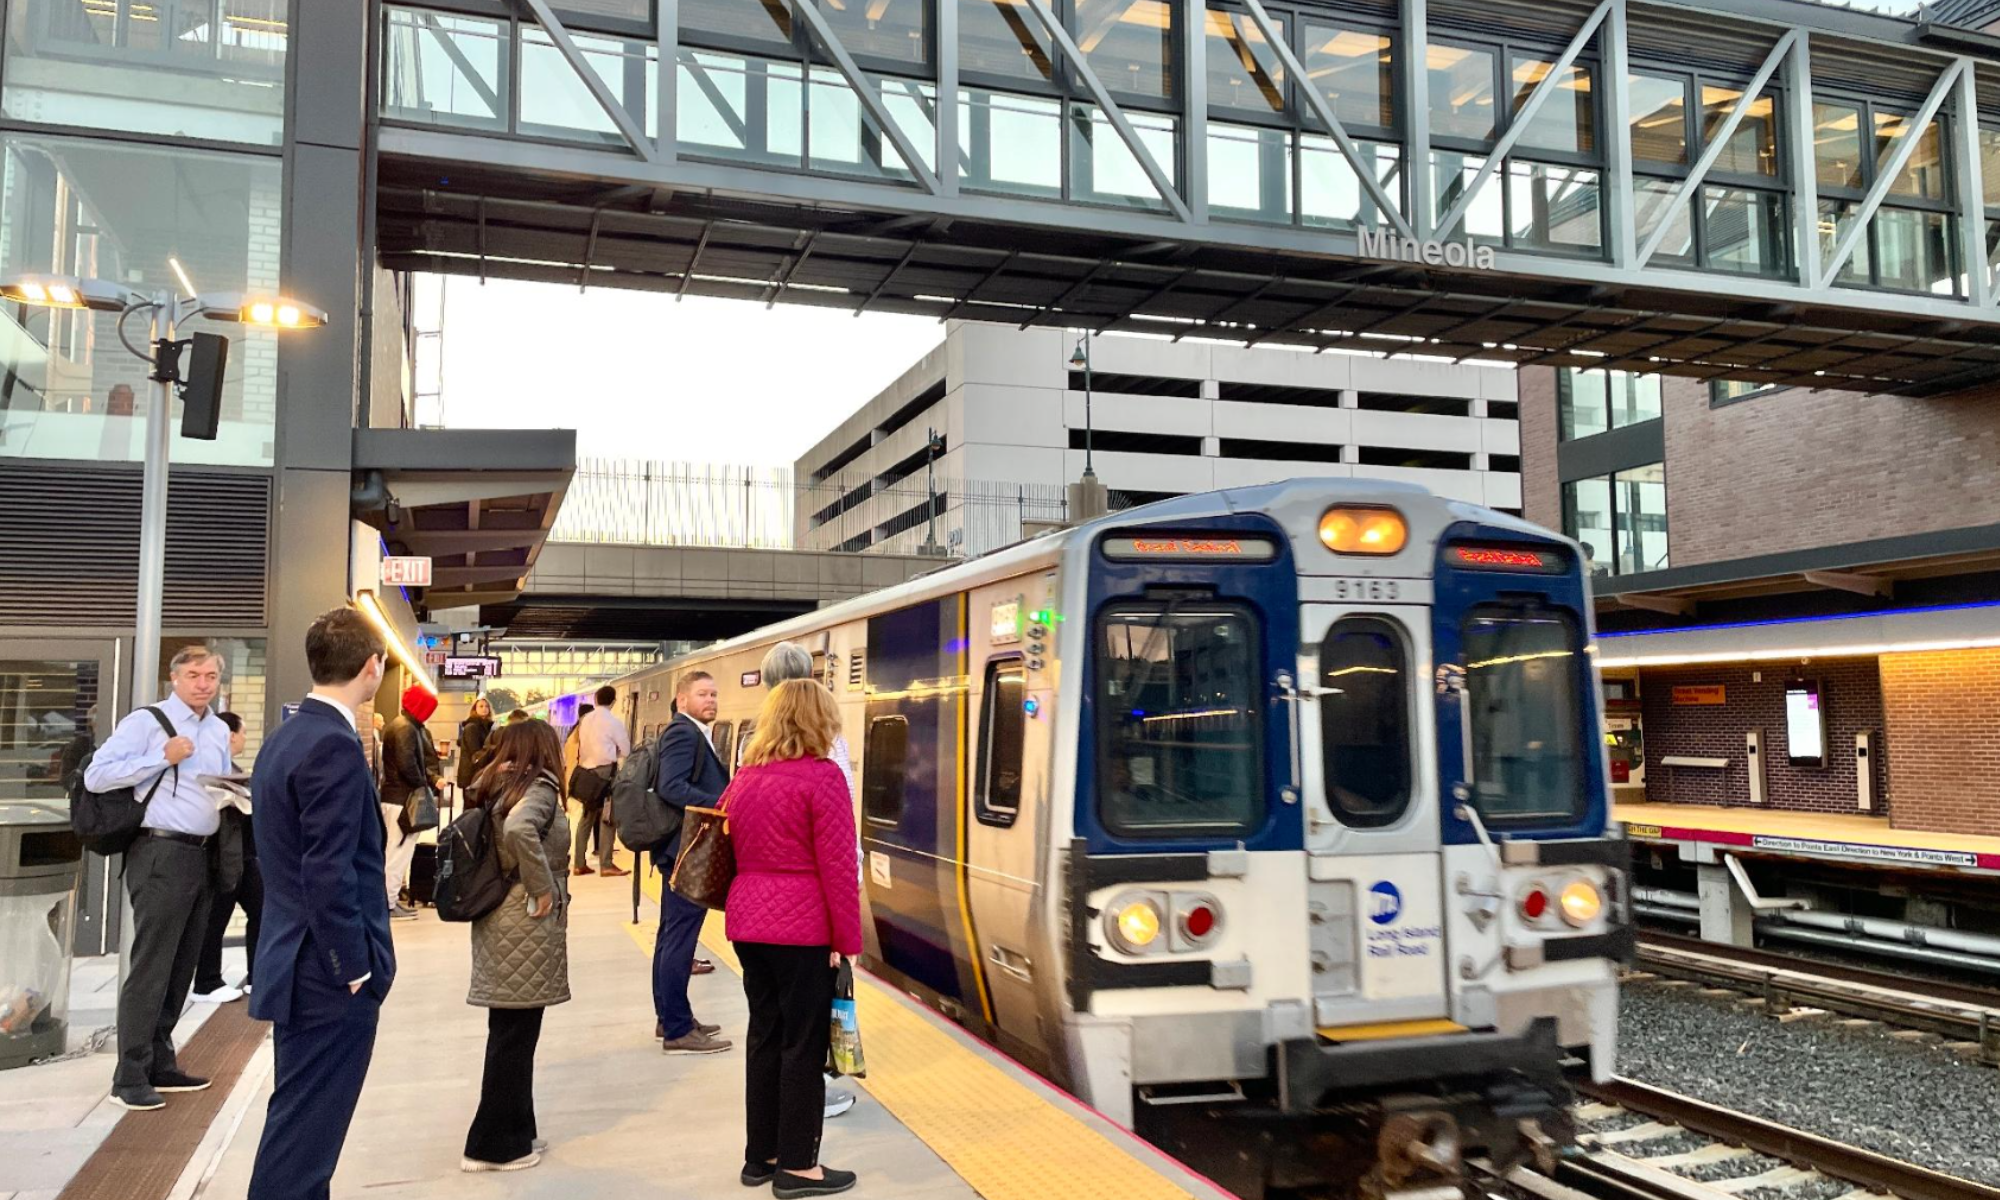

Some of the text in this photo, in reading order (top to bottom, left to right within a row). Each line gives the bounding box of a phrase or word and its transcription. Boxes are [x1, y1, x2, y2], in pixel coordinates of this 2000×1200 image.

[1358, 224, 1495, 270] Mineola
[390, 559, 427, 582] EXIT
[1334, 579, 1400, 600] 9163
[1762, 838, 1792, 848] Direction
[1802, 842, 1822, 851] Points
[1824, 843, 1840, 852] East
[1841, 845, 1871, 855] Direction
[1880, 849, 1896, 858] New
[1898, 851, 1912, 859] York
[1921, 852, 1944, 861] Points
[1945, 854, 1964, 864] West
